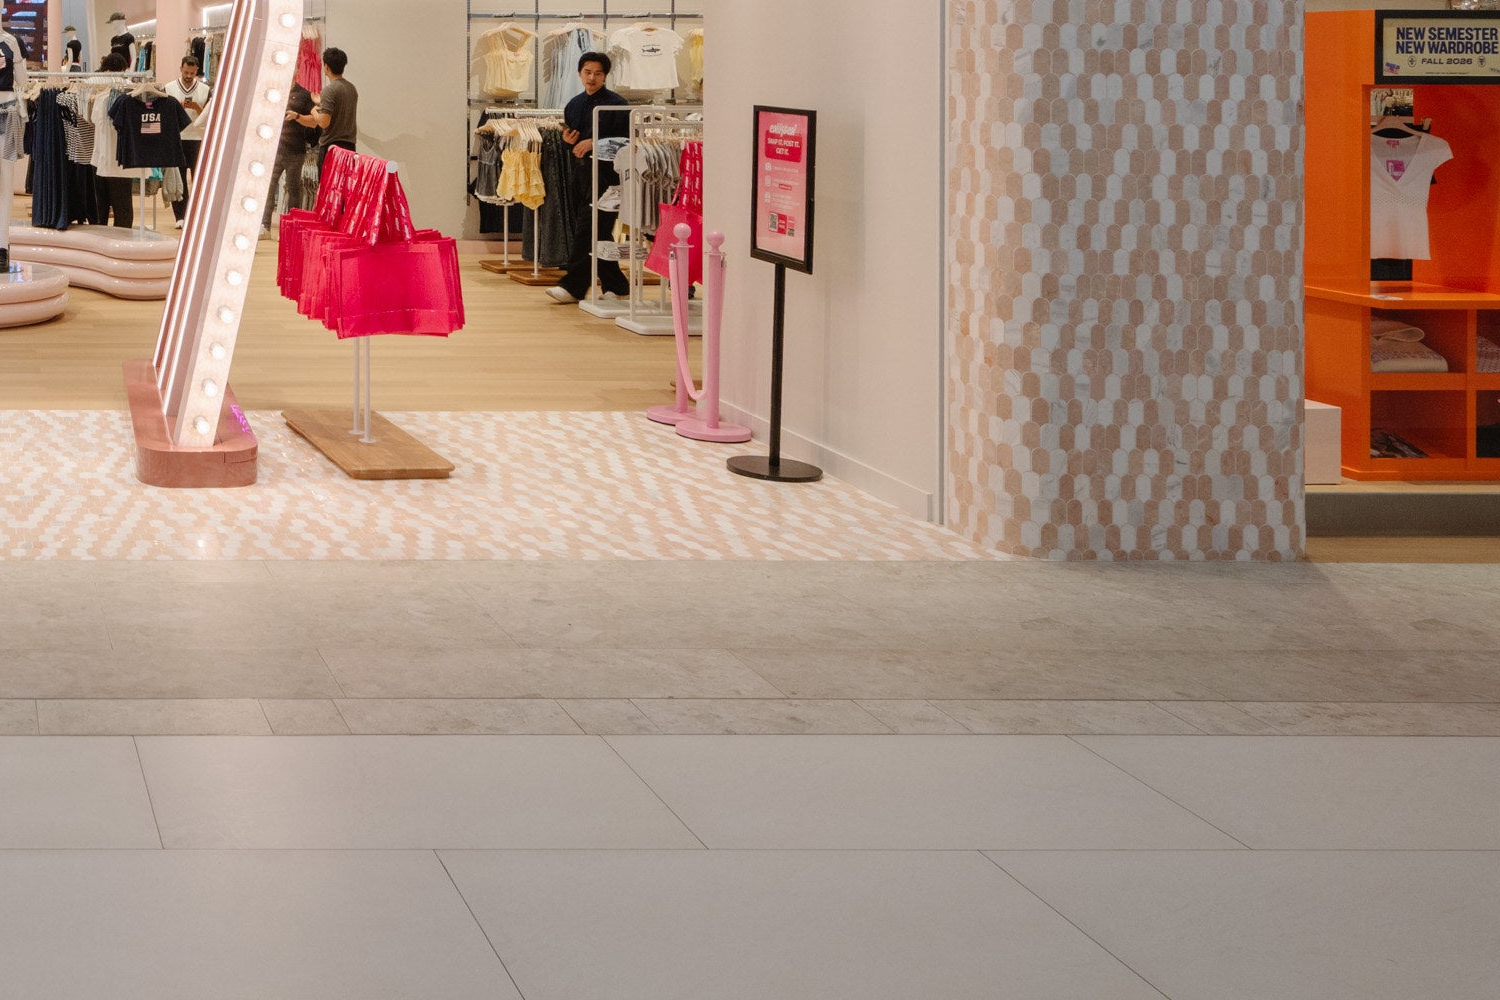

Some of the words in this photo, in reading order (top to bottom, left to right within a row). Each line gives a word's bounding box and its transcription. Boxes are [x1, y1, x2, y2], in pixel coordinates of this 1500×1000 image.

[1396, 27, 1426, 40] NEW
[1428, 27, 1498, 40] SEMESTER
[1396, 41, 1425, 54] NEW
[1427, 41, 1499, 54] WARDROBE
[141, 113, 161, 122] USA
